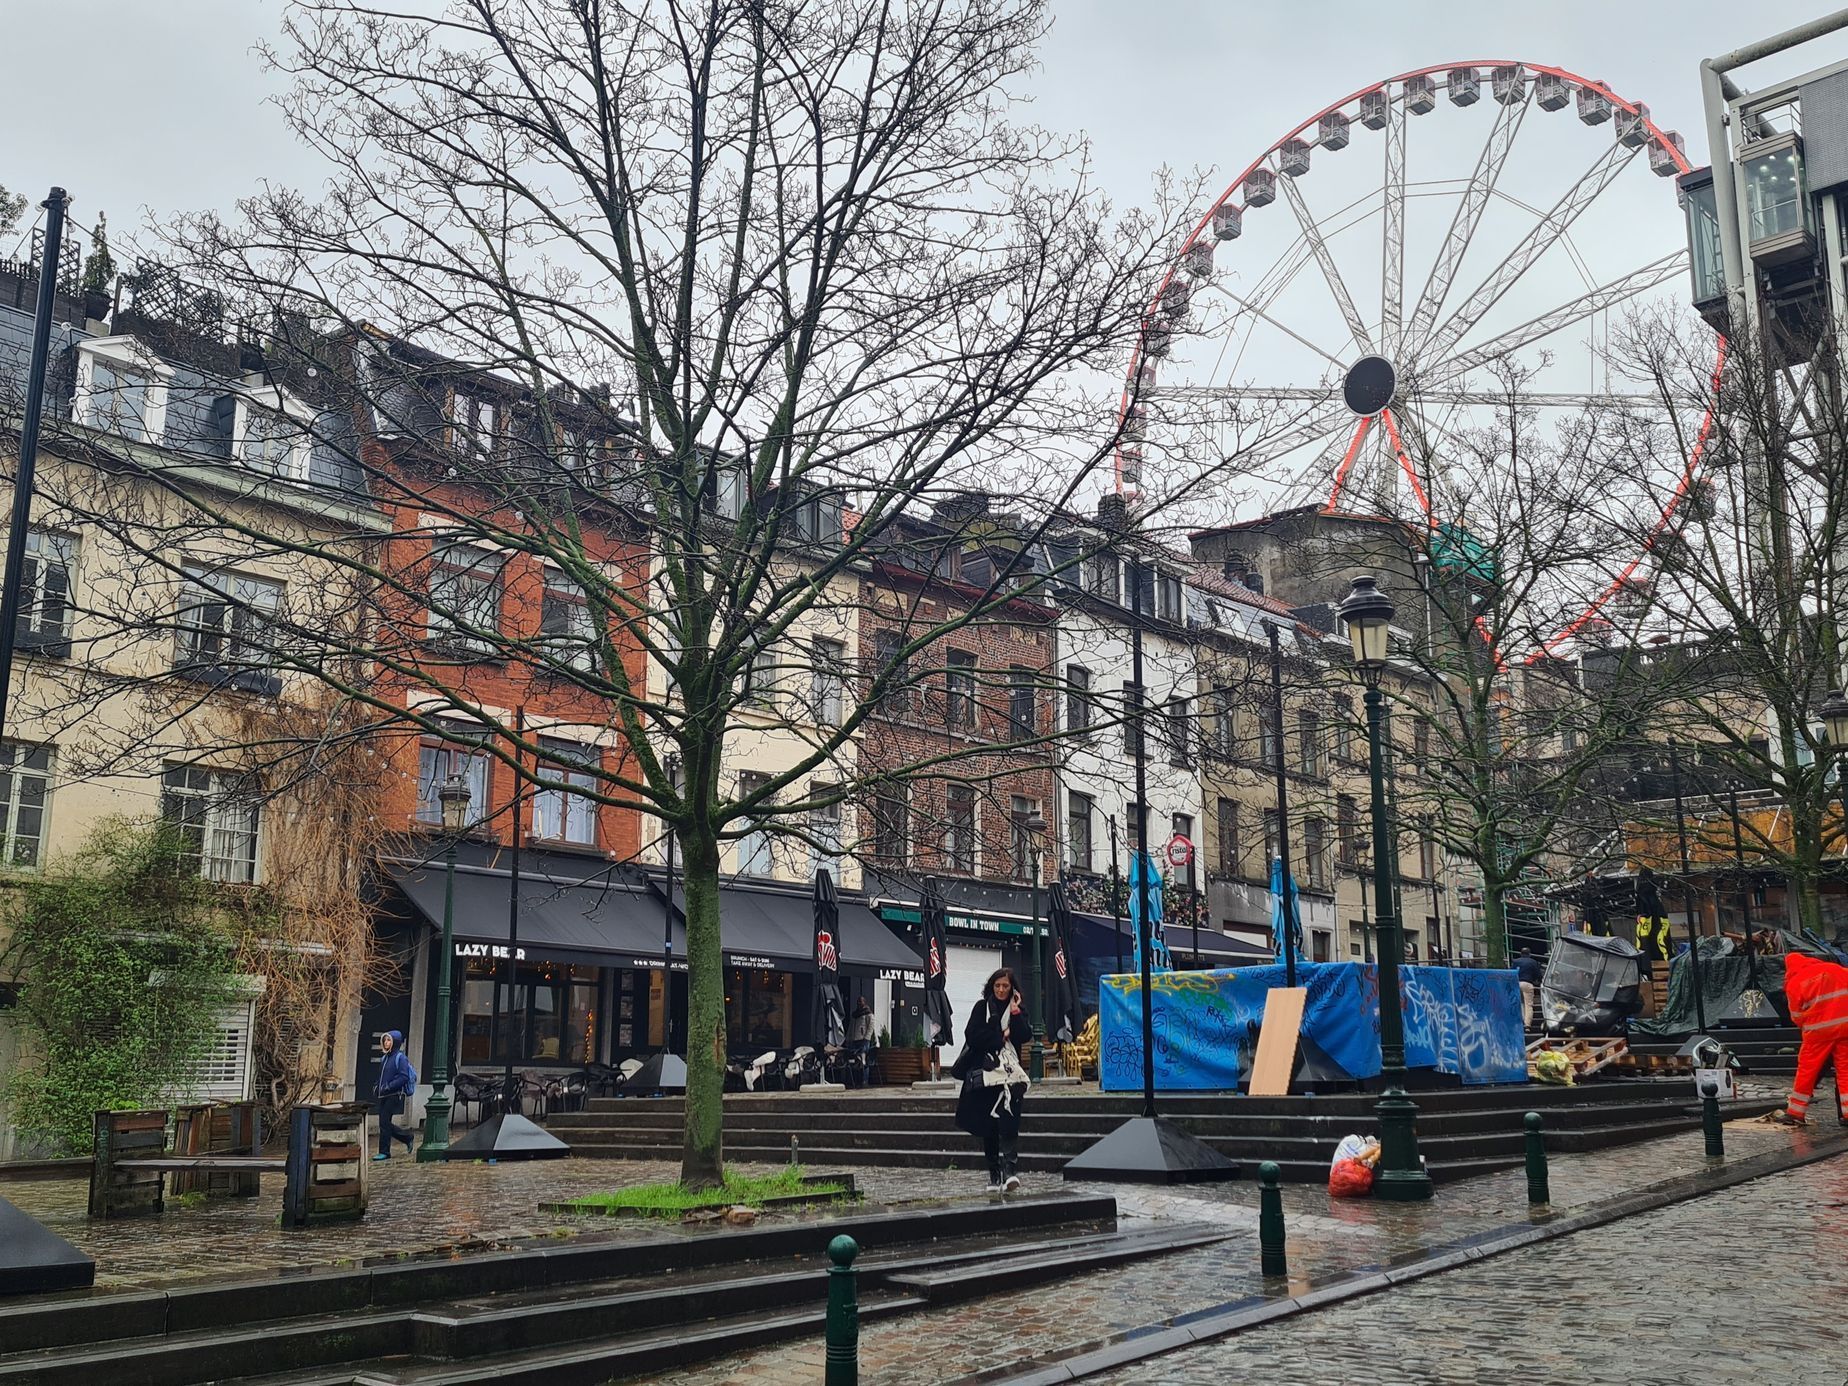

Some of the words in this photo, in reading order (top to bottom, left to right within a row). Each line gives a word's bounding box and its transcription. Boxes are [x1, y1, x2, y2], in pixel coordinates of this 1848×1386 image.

[949, 917, 969, 929] BOWL
[970, 918, 978, 929] IN
[979, 920, 999, 932] TOWN
[455, 944, 488, 956] LAZY
[492, 945, 526, 960] BER
[880, 969, 902, 980] LAZY
